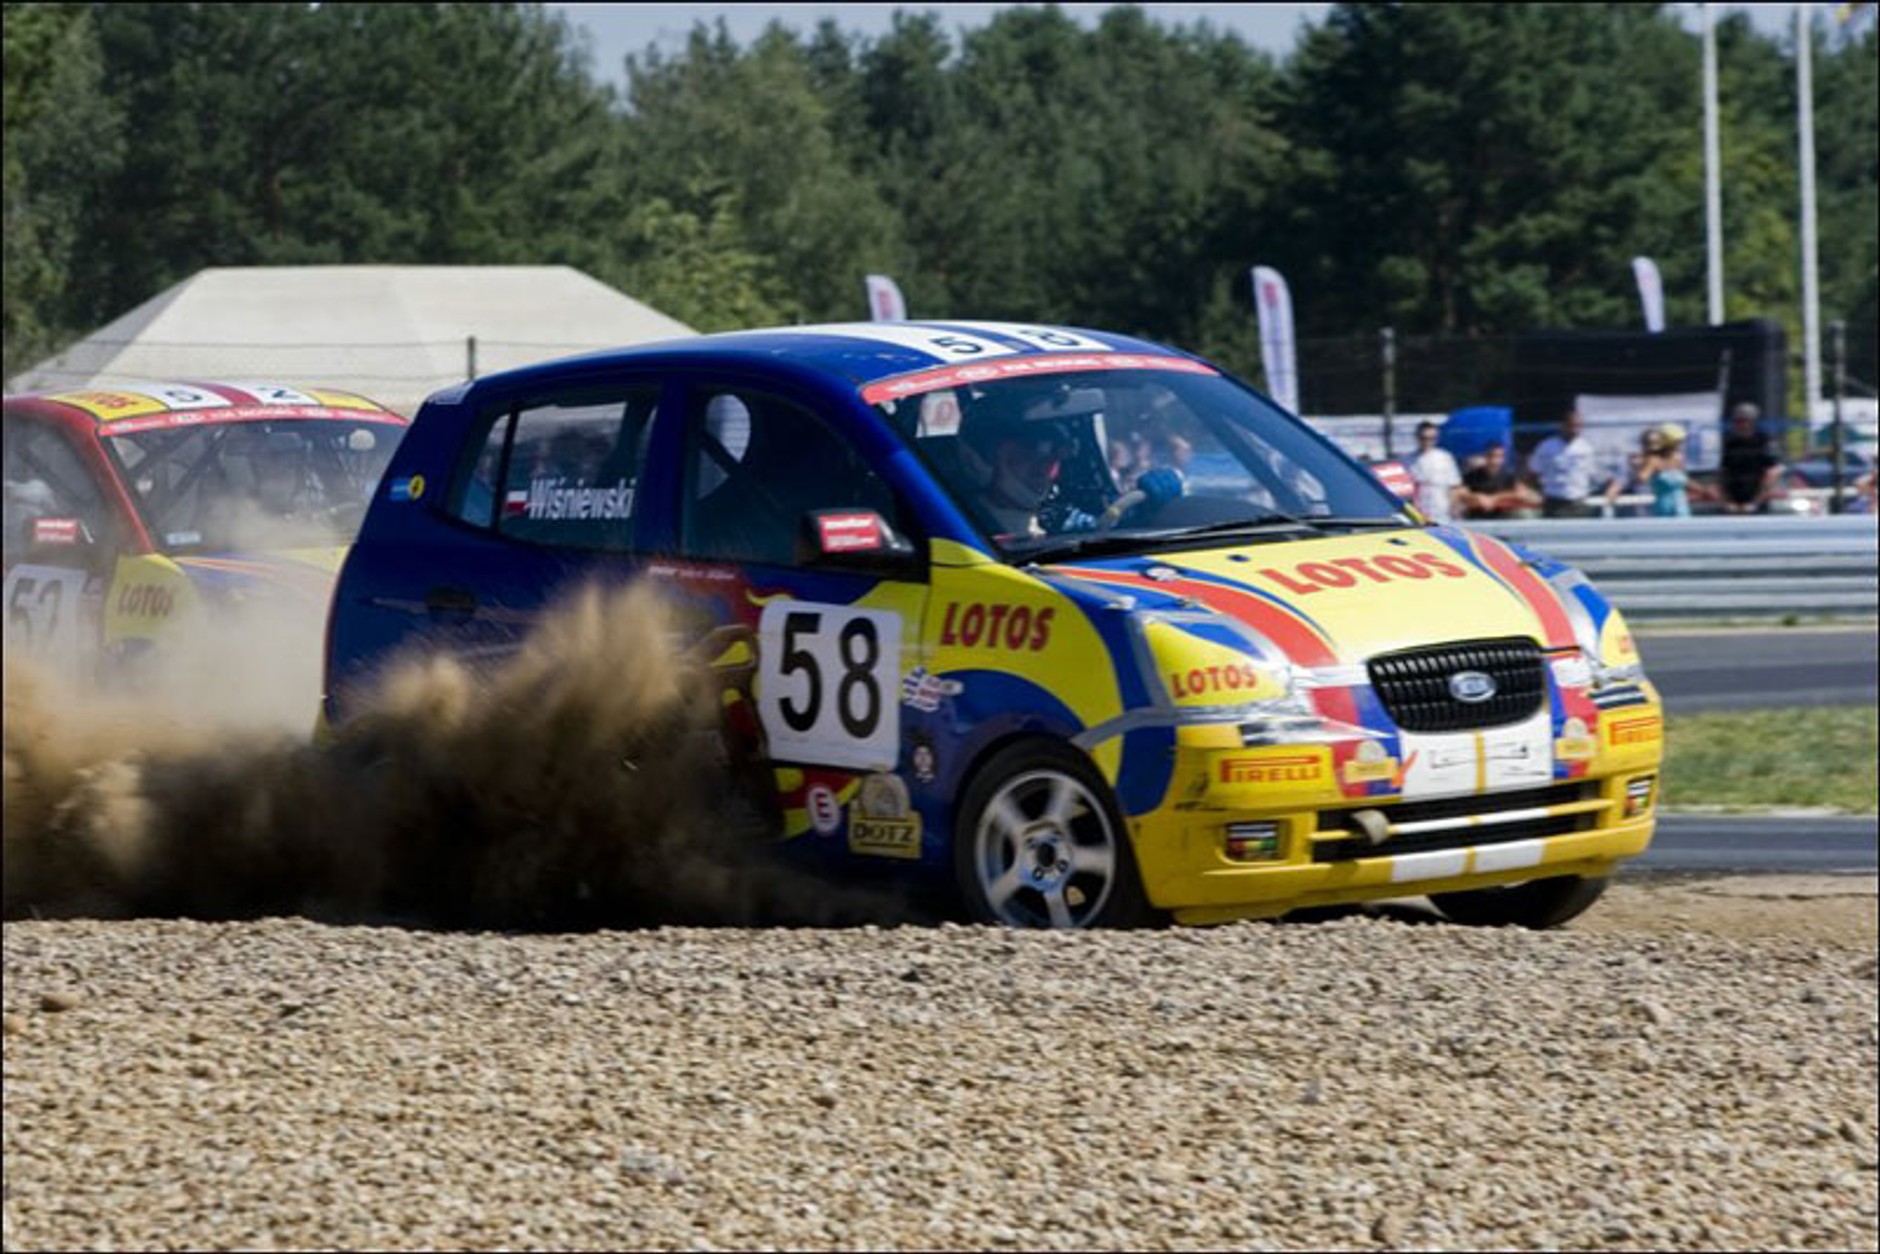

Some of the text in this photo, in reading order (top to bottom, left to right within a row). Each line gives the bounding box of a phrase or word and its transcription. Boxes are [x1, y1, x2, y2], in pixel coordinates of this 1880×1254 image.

[528, 477, 638, 520] Wiśniewski
[1259, 552, 1467, 595] LOTOS
[940, 601, 1056, 652] LOTOS
[778, 611, 881, 740] 58
[1171, 664, 1257, 699] LOTOS
[1219, 755, 1322, 784] PIRELLI
[853, 822, 916, 843] DOTZ
